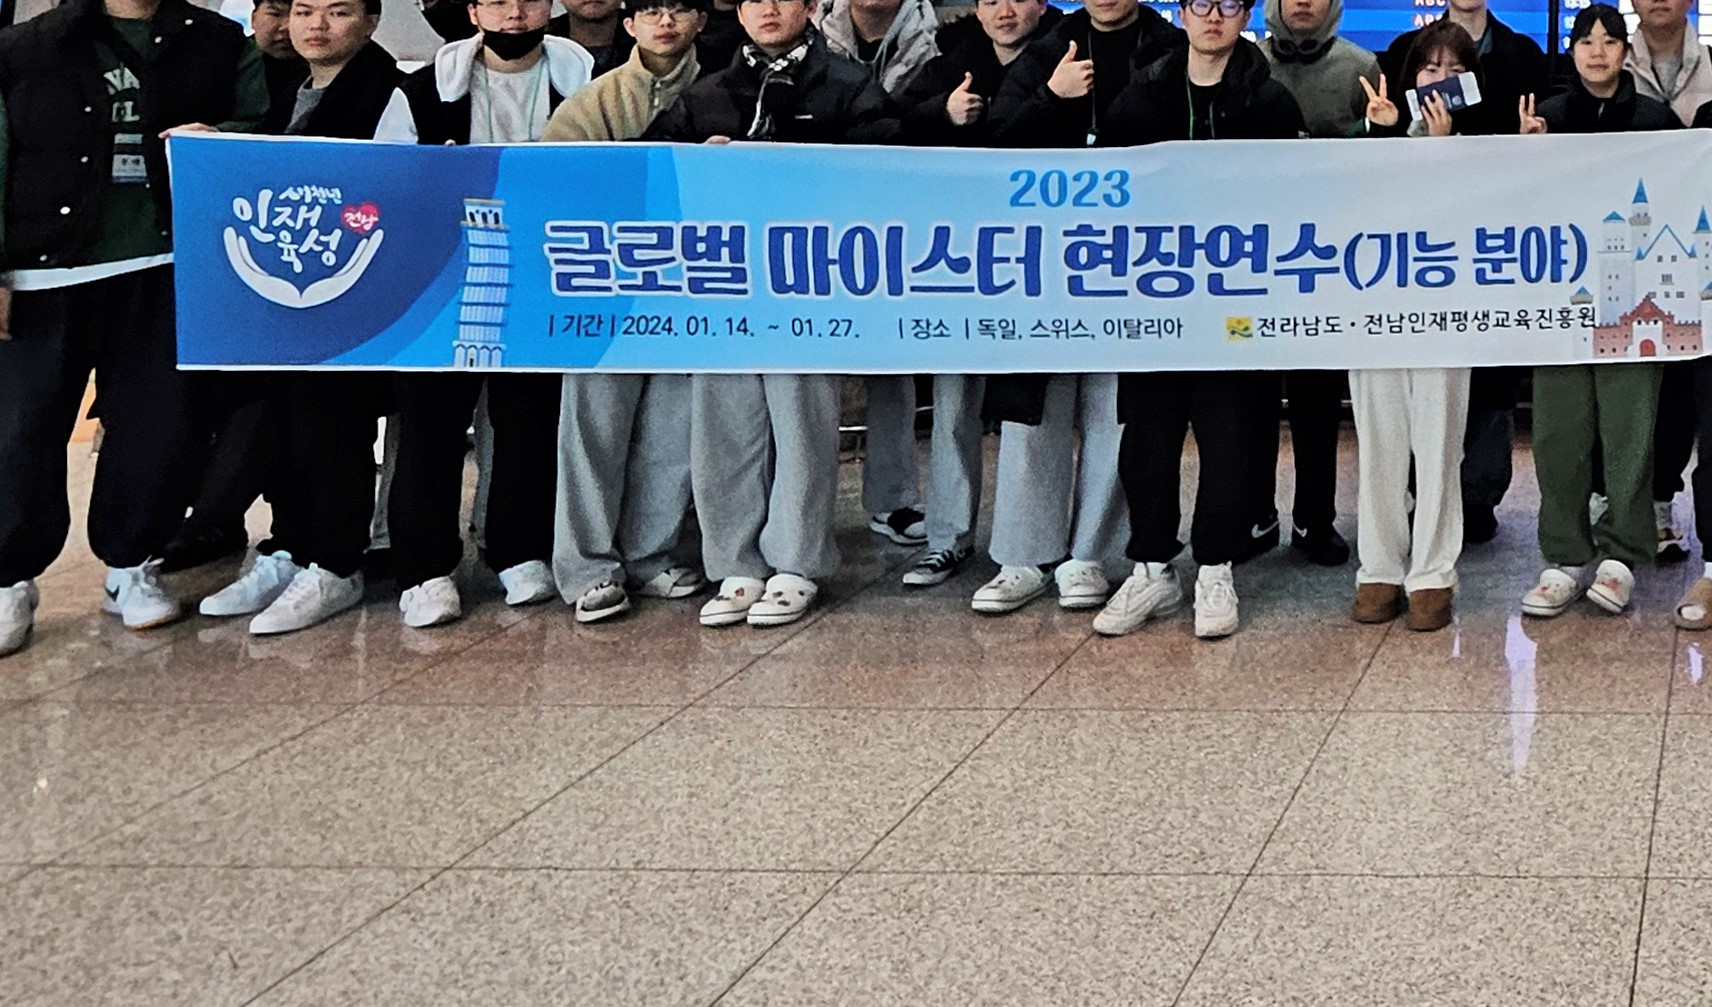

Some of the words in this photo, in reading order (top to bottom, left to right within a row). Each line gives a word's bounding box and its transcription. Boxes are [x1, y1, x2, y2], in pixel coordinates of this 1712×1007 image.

[1008, 168, 1131, 208] 2023
[233, 189, 322, 242] 인재
[344, 212, 379, 230] 전남
[277, 228, 342, 273] 육성
[547, 223, 749, 296] 글로벌
[767, 224, 1044, 297] 마이스터
[1062, 222, 1459, 298] 현장연수(기능
[1473, 222, 1589, 289] 분야)
[560, 314, 603, 337] 기간
[622, 314, 679, 336] 2024.
[685, 315, 716, 336] 01.
[726, 315, 754, 337] 14.
[791, 317, 822, 338] 01.
[830, 317, 860, 338] 27.
[910, 317, 949, 340] 장소
[977, 318, 1023, 340] 독일,
[1030, 317, 1096, 341] 스위스,
[1103, 317, 1183, 340] 이탈리아
[1257, 315, 1343, 338] 전라남도
[1363, 305, 1598, 334] 전남인재평생교육진흥원
